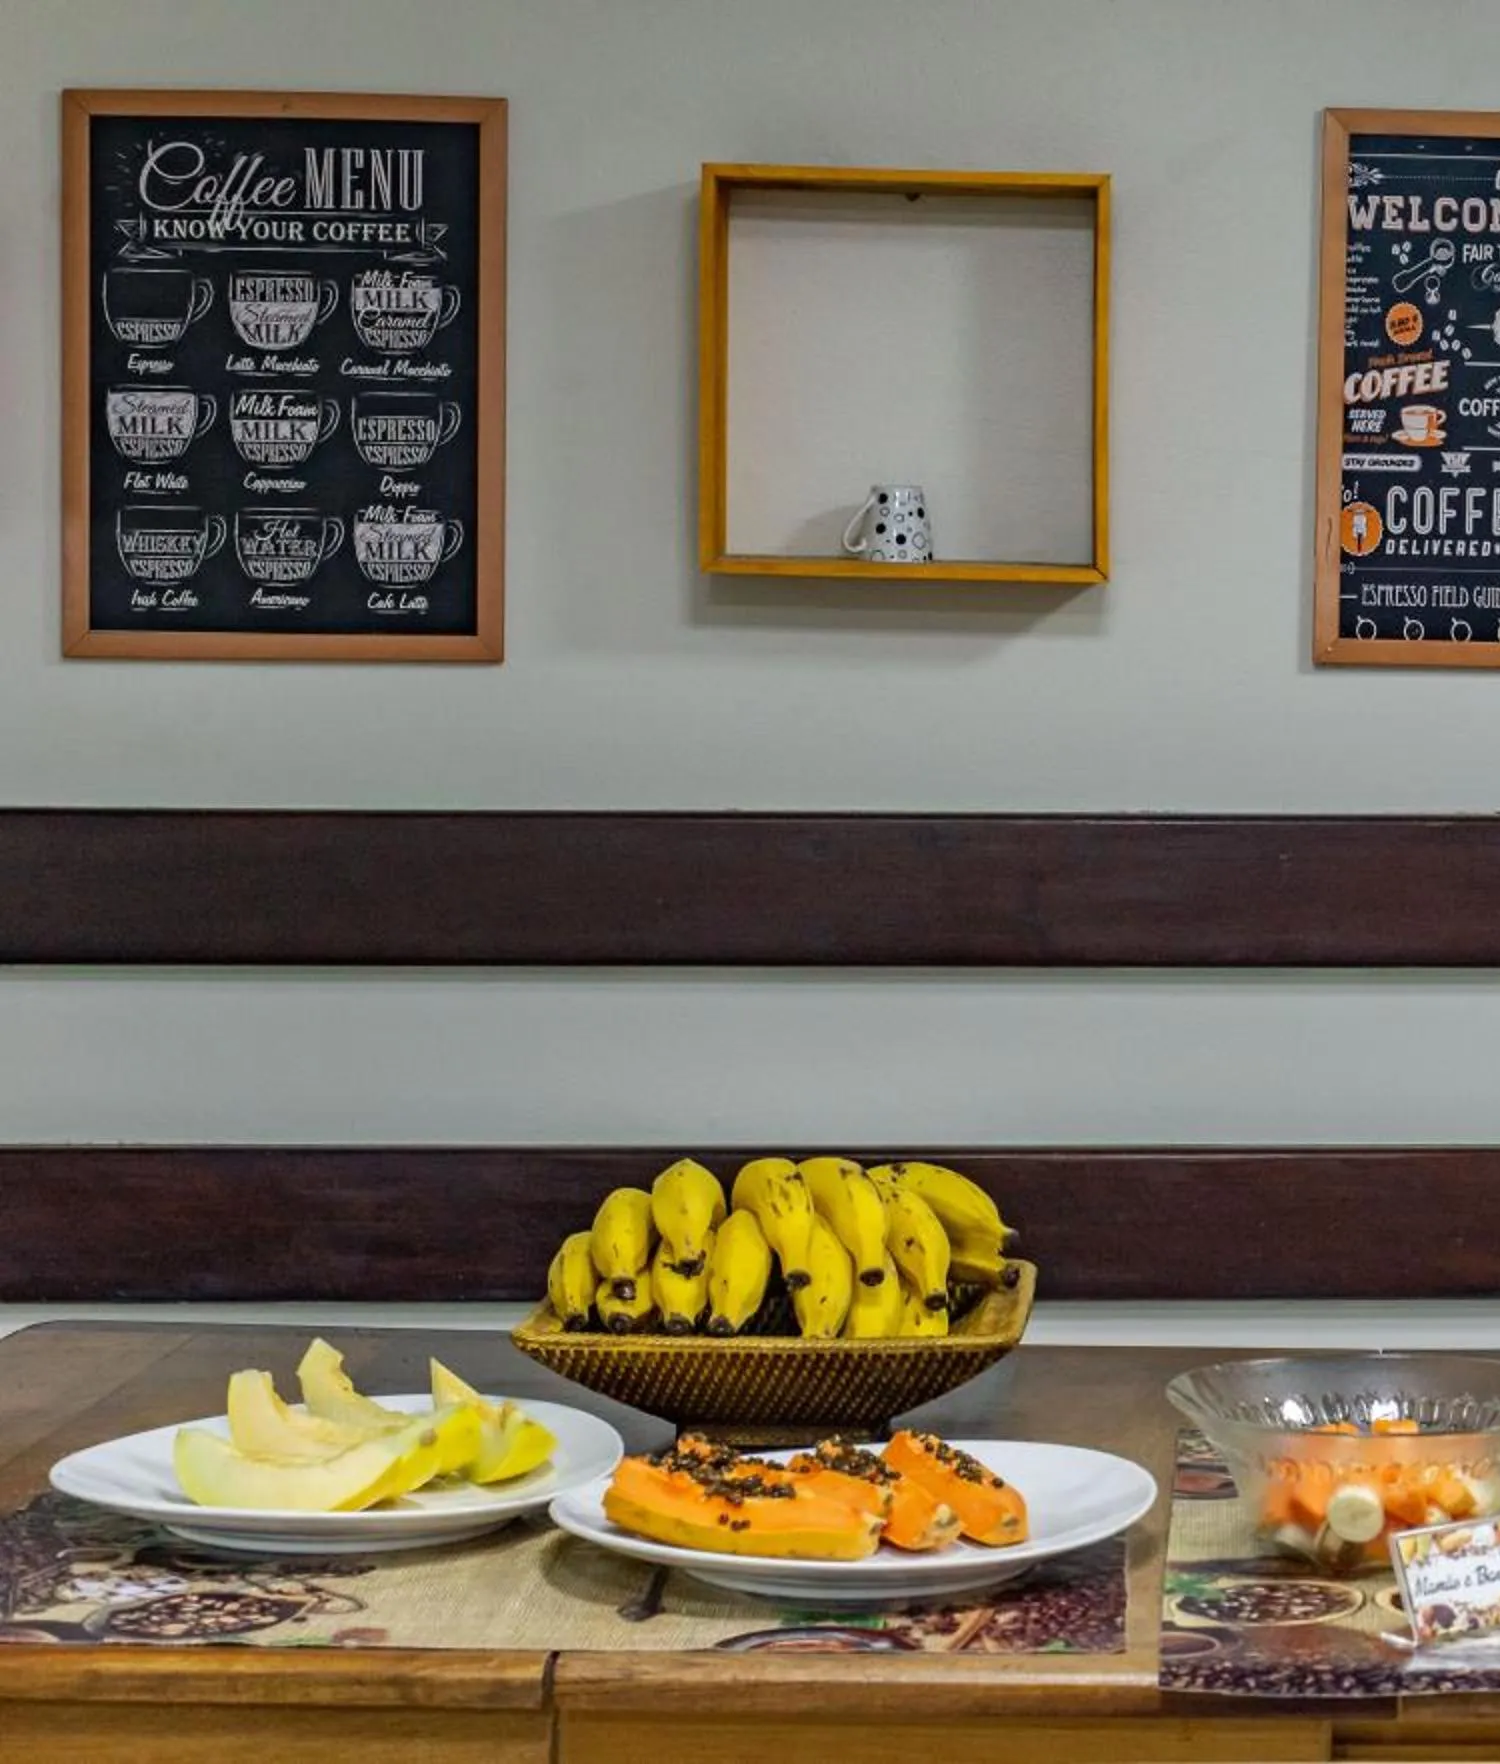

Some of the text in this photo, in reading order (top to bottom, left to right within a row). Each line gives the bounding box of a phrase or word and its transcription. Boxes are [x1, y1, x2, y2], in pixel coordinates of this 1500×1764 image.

[139, 140, 424, 231] Coffee MENU
[153, 219, 412, 242] KNOW YOUR COFFEE
[1463, 244, 1494, 264] FAIR
[236, 280, 314, 301] ESPRESSO
[363, 290, 431, 309] MILK
[358, 309, 433, 331] Caramel
[116, 321, 181, 343] ESPRESSO
[241, 323, 303, 343] MILK
[363, 328, 429, 348] ESPRESSO
[1344, 360, 1450, 404] COFFEE
[235, 395, 319, 418] Milk Foam
[118, 417, 186, 436] MILK
[241, 422, 308, 442] MILK
[358, 418, 436, 441] ESPRESSO
[120, 438, 183, 458] ESPRESSO
[243, 443, 306, 462] ESPRESSO
[364, 446, 429, 466] ESPRESSO
[364, 506, 395, 523] Milk
[122, 532, 205, 555] WHISKEY
[243, 537, 317, 557] WATER
[364, 541, 432, 562] MILK
[1385, 539, 1491, 557] DELIVERED
[130, 558, 194, 579] ESPRESSO
[248, 560, 311, 581] ESPRESSO
[367, 563, 431, 585] ESPRESSO
[1362, 583, 1427, 606] ESPRESSO
[1431, 585, 1469, 607] FIELD
